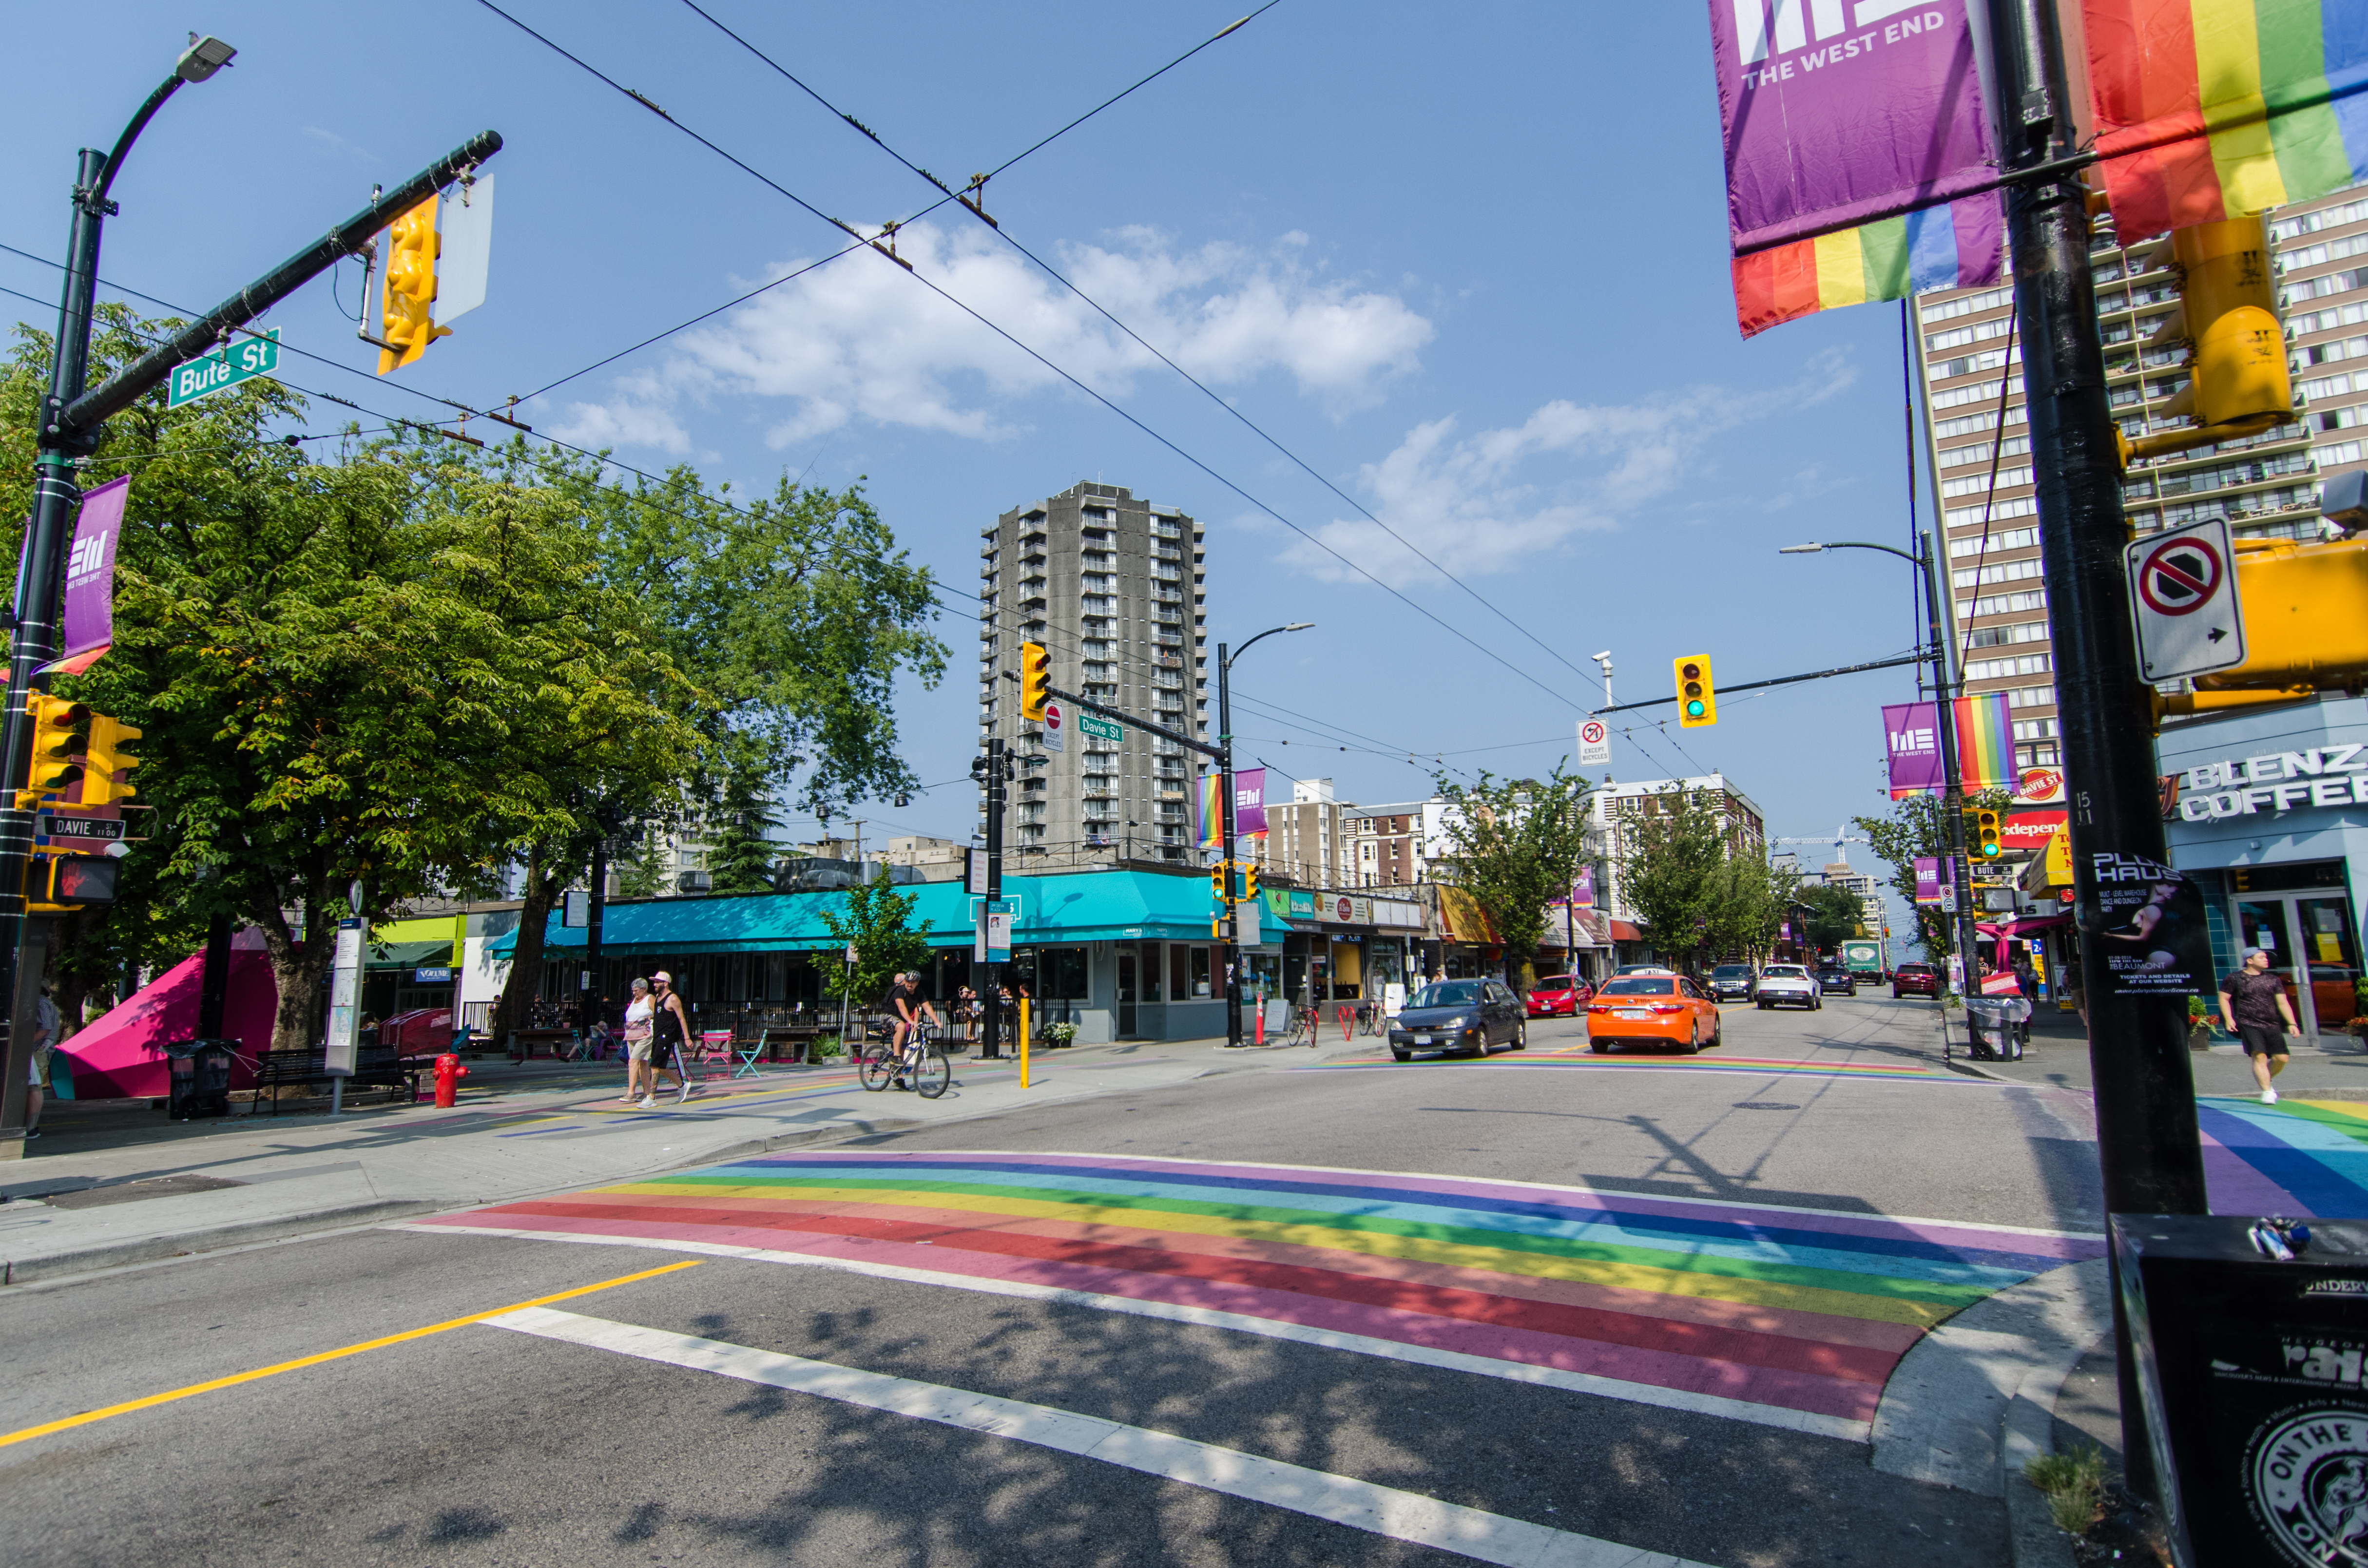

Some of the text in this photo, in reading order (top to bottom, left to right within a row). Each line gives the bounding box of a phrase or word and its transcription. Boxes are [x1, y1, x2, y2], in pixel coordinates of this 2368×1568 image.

[1741, 60, 1794, 90] THE
[1801, 32, 1877, 72] WEST
[1885, 11, 1944, 44] END
[179, 343, 268, 397] Bute St
[1082, 719, 1119, 739] Davie St
[1045, 738, 1061, 747] BICYCLES
[2188, 743, 2368, 791] BLENZ
[2020, 774, 2058, 796] DAVIE ST
[56, 820, 91, 835] DAVIE
[2002, 823, 2062, 837] ndepen
[2096, 867, 2183, 882] HAUS
[2281, 1336, 2303, 1345] HE
[2214, 1371, 2253, 1380] VANCOUVER'S
[2280, 1377, 2331, 1388] ENTERTAINMENT
[2308, 1398, 2328, 1408] Arts
[2271, 1424, 2351, 1480] ON THE
